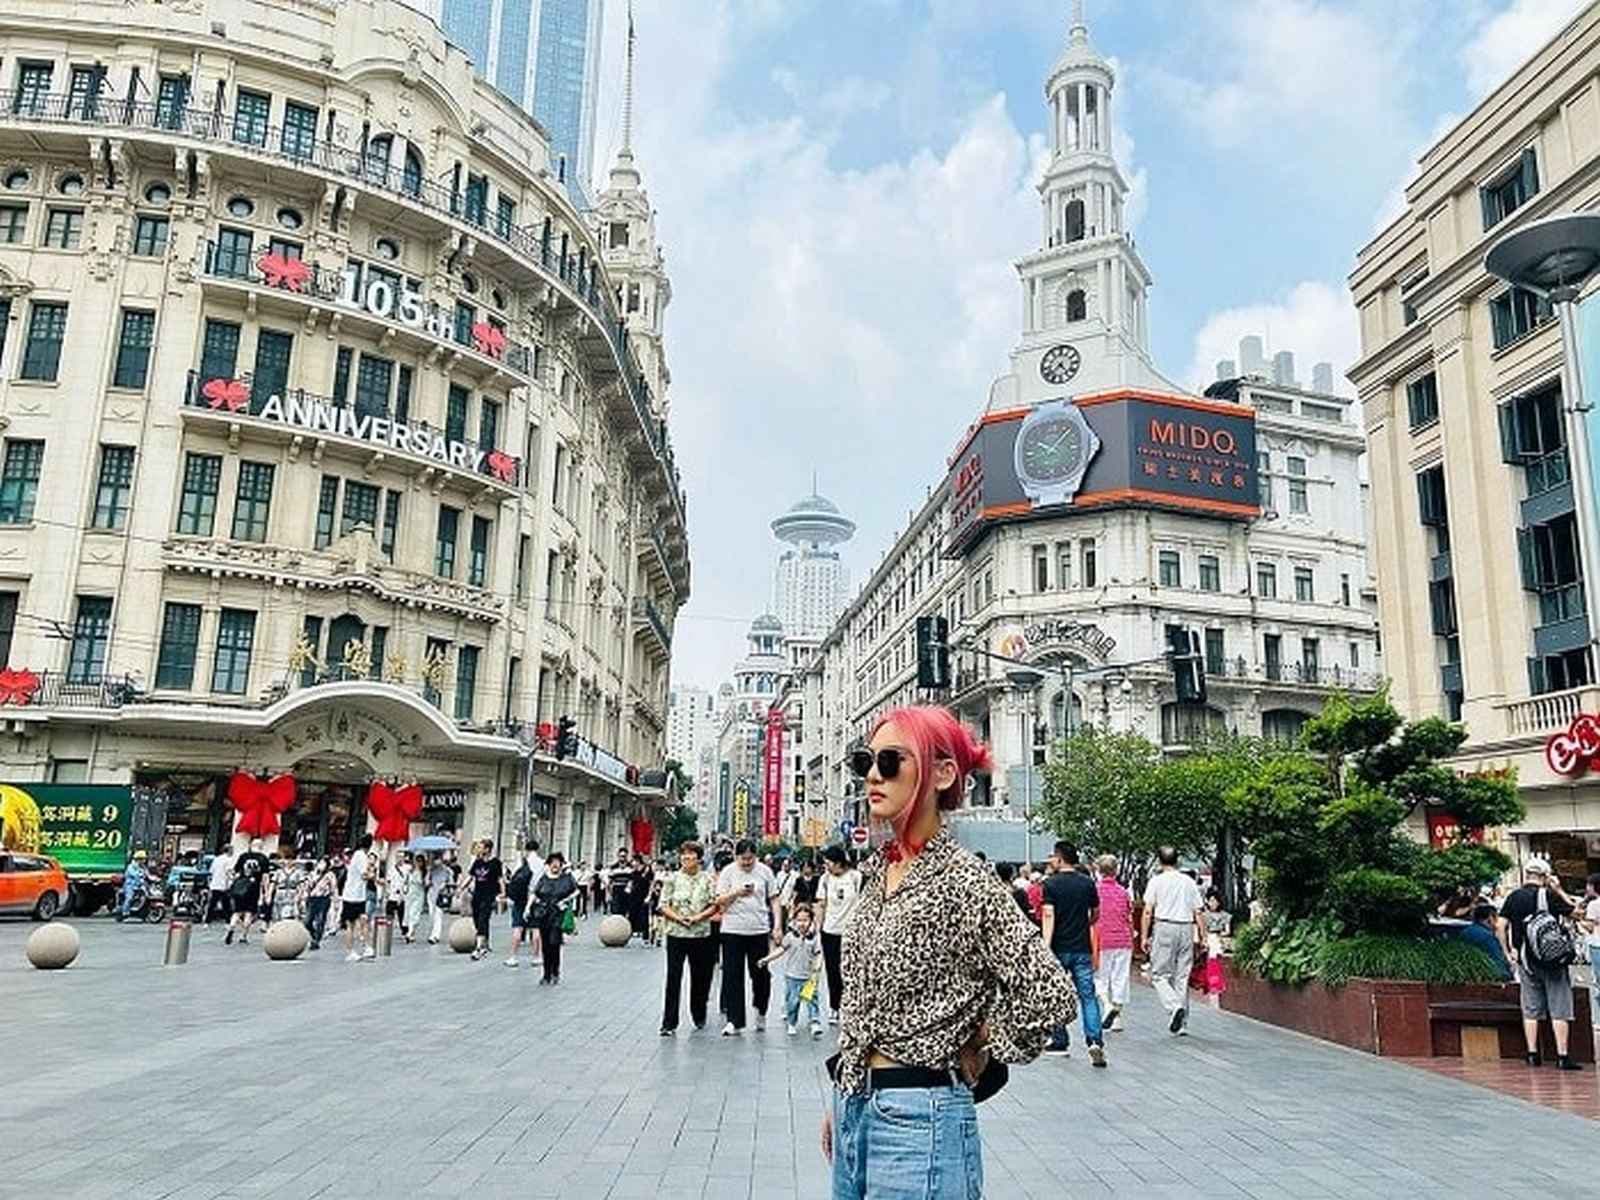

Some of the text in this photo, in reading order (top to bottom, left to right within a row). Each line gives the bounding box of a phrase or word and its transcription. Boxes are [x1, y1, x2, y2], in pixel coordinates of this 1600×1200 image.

[336, 267, 455, 340] 105th
[259, 395, 485, 474] ANNIVERSARY
[1150, 418, 1235, 454] MIDO
[102, 804, 118, 823] 9
[92, 829, 122, 849] 20
